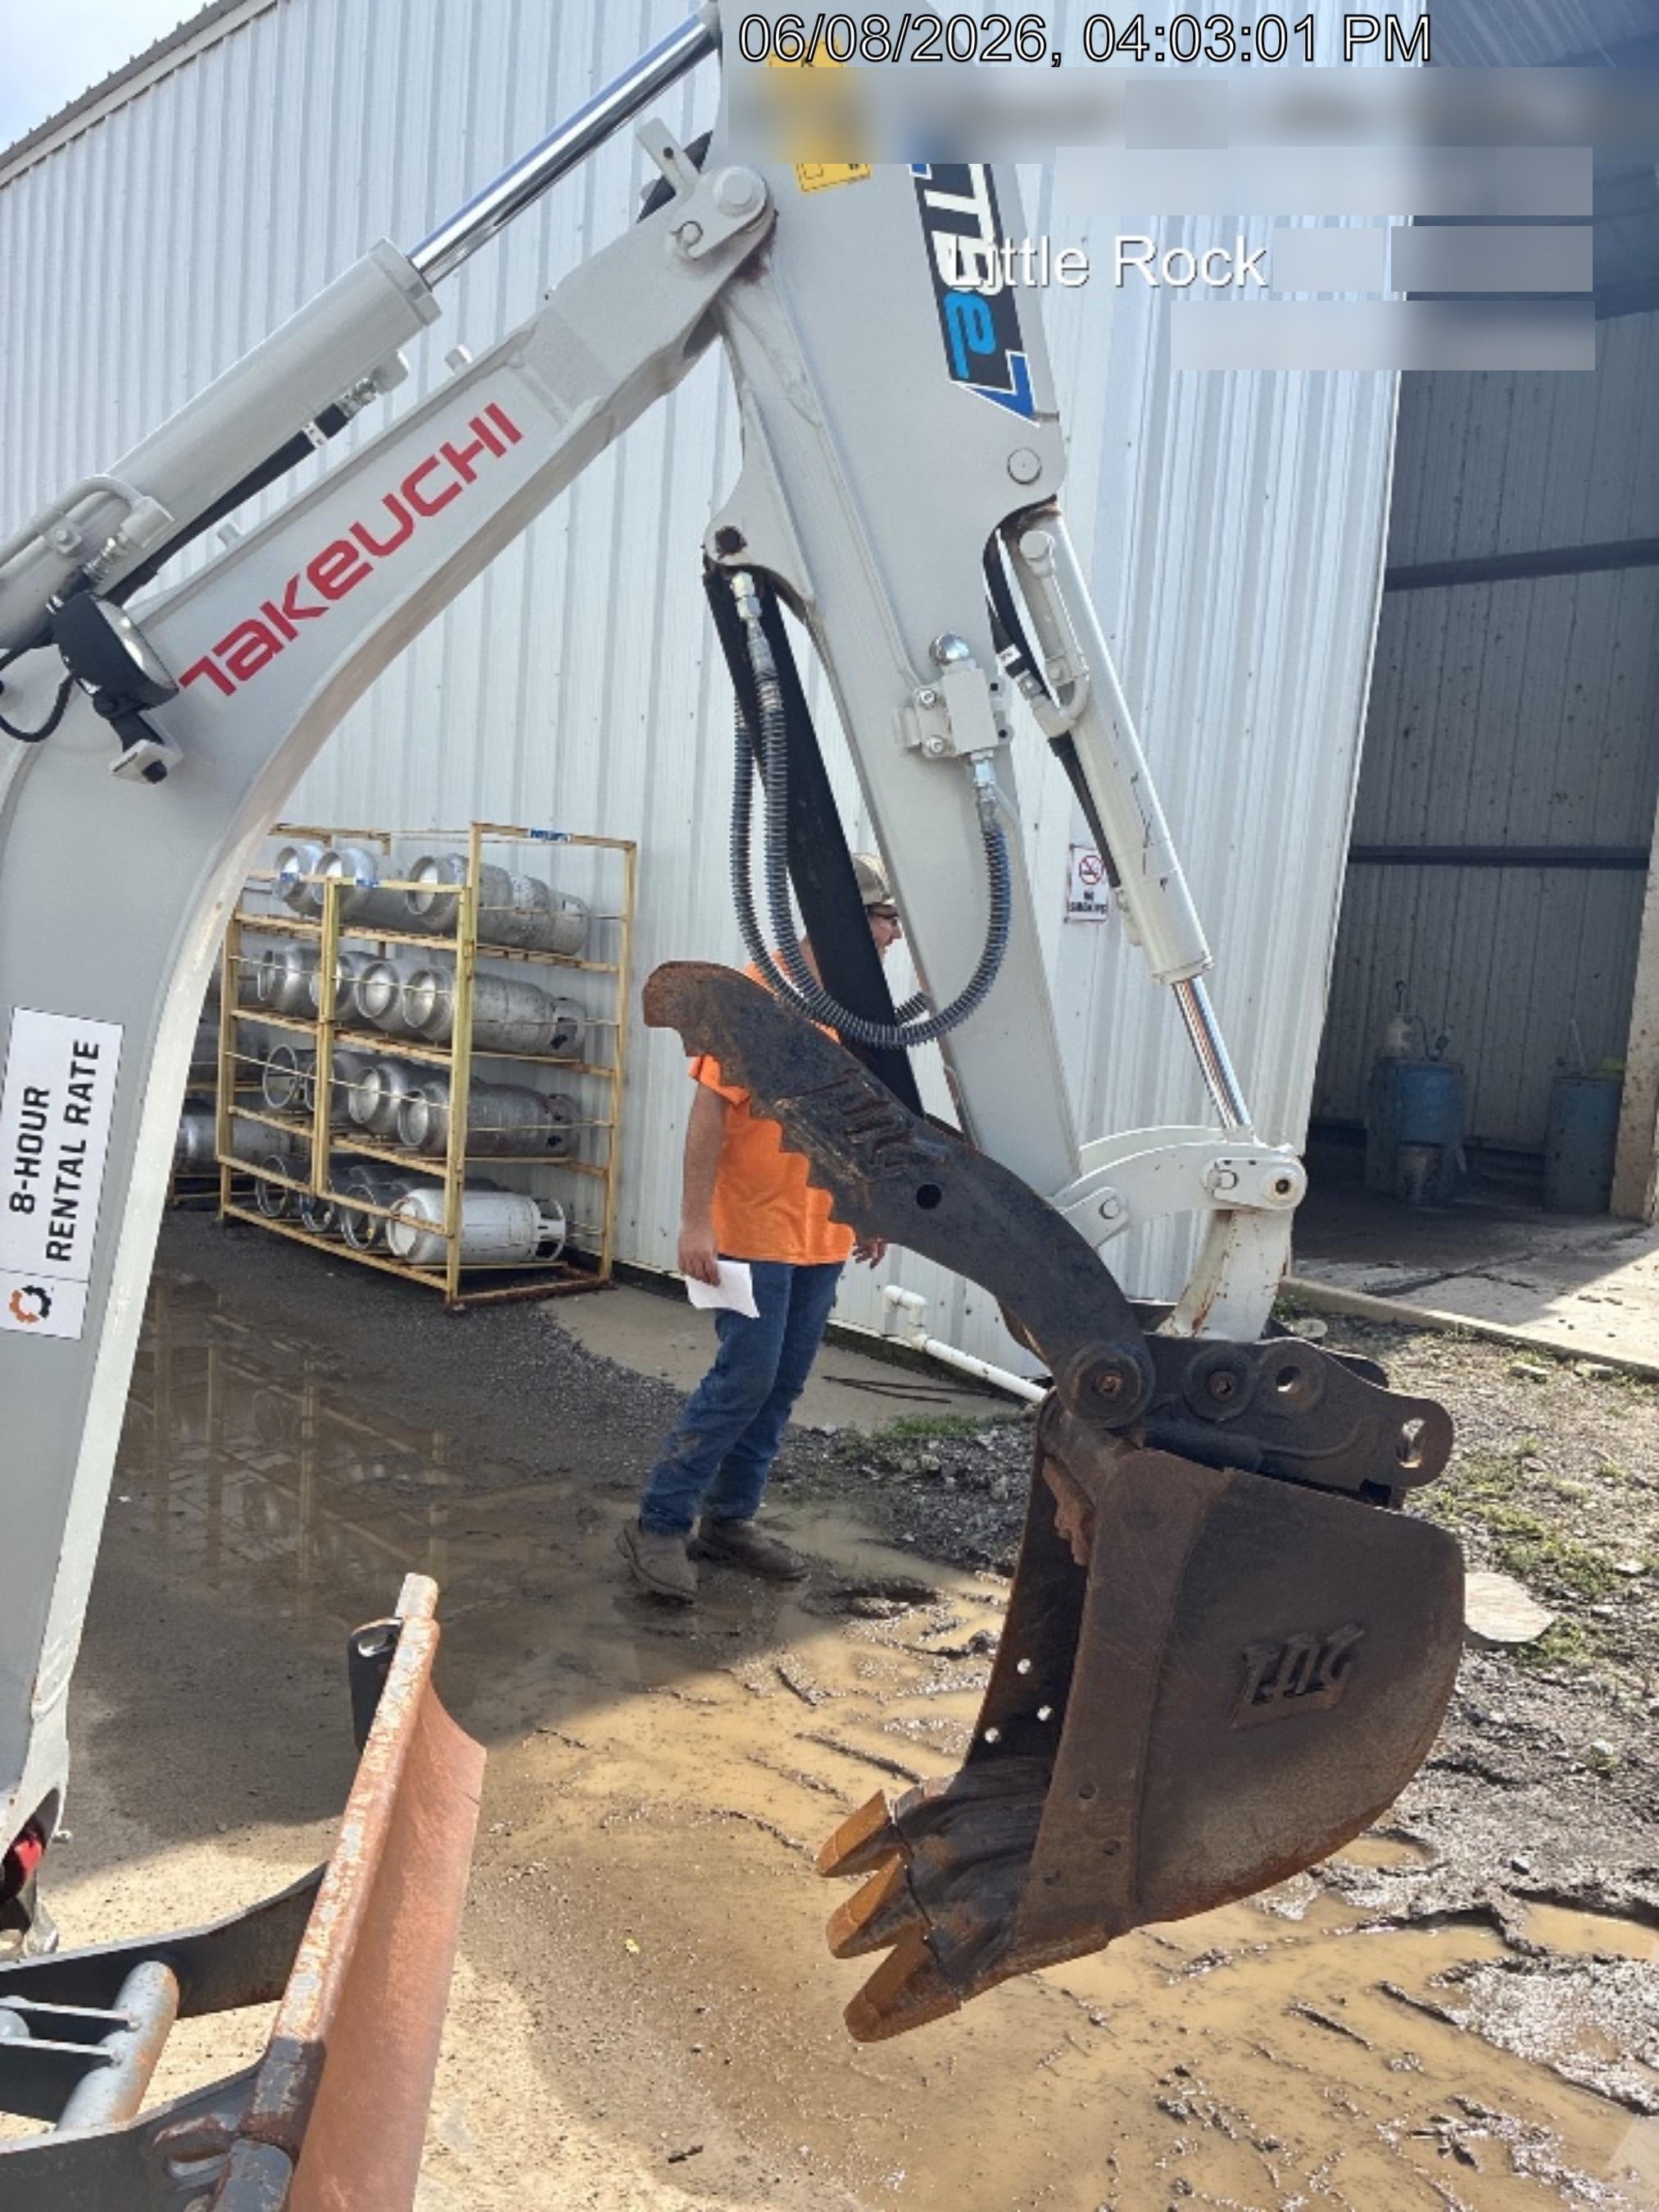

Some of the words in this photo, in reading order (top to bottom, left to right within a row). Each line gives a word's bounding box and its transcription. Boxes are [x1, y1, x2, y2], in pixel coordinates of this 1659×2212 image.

[64, 1039, 101, 1125] RATE
[9, 1086, 51, 1214] 8-HOUR
[46, 1139, 87, 1262] RENTAL
